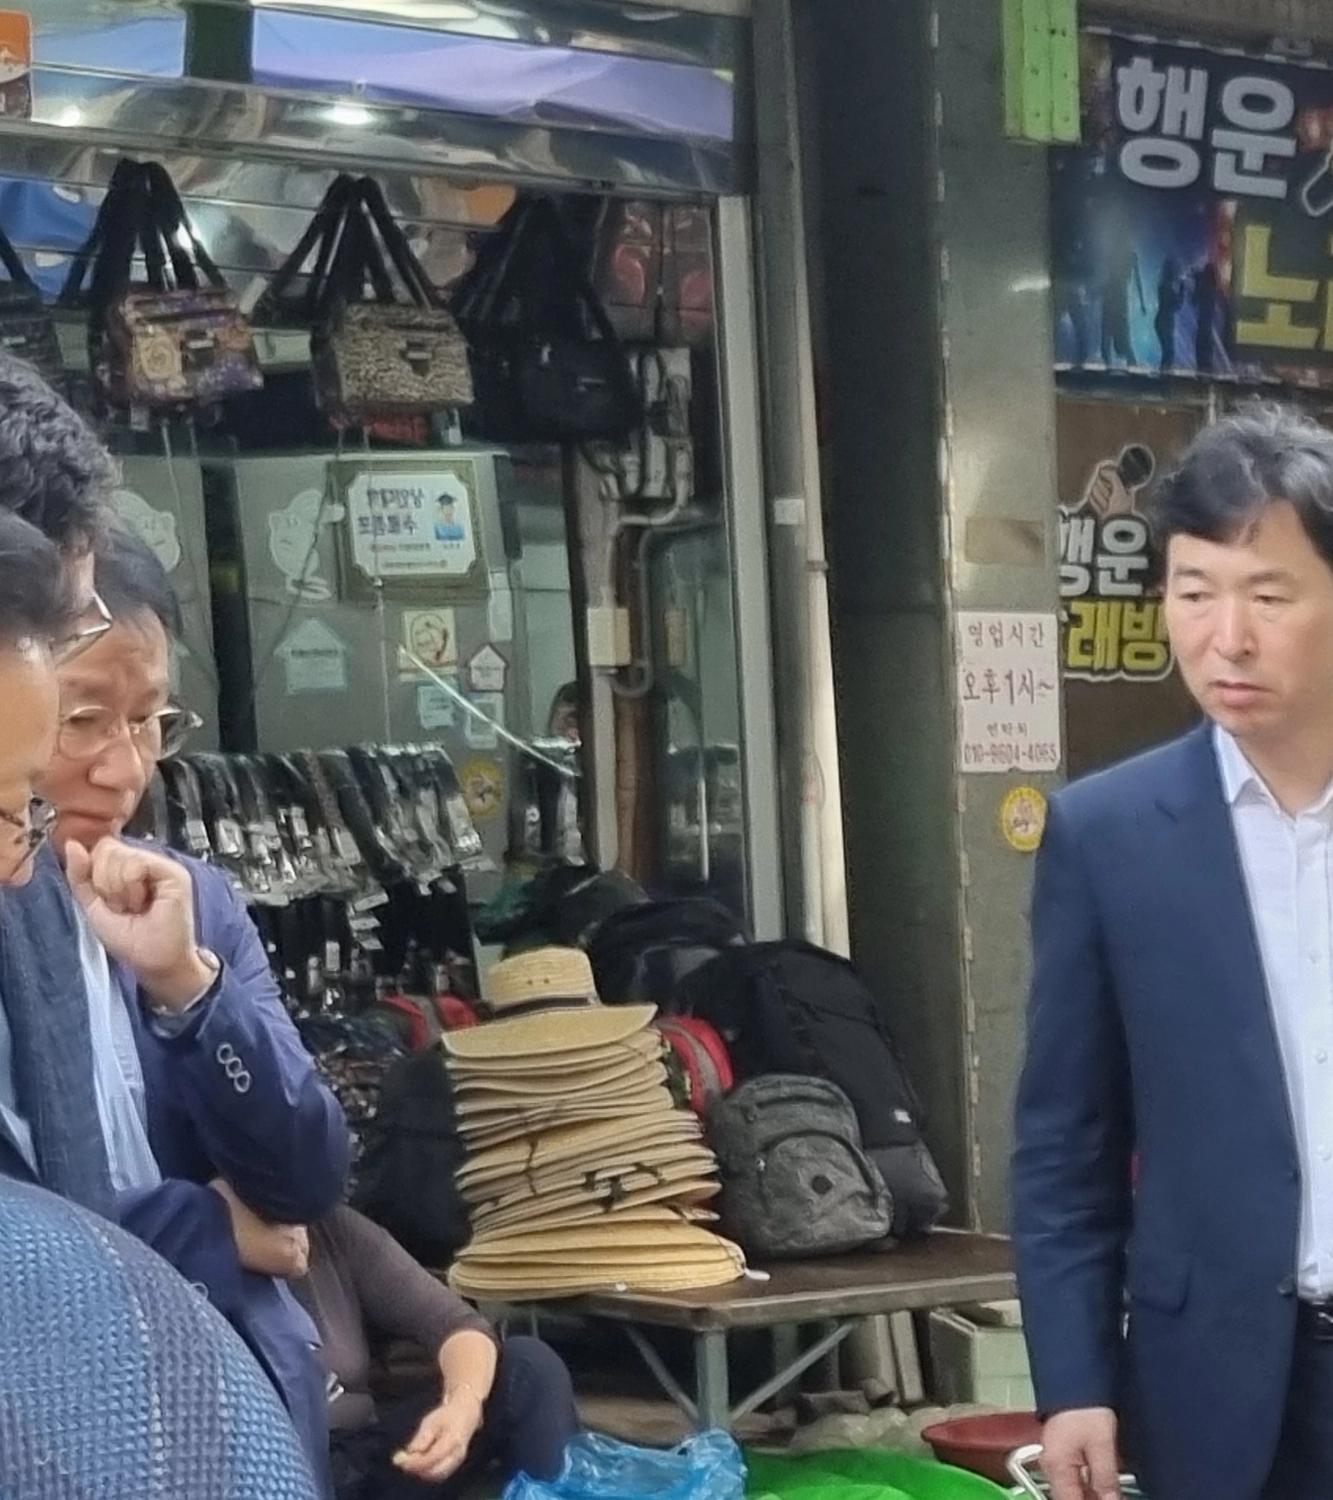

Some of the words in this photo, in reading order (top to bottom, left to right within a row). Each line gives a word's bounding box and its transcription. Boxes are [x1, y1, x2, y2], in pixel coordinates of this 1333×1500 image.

[1116, 54, 1298, 200] 행운
[967, 620, 1046, 650] 영업시간
[1060, 600, 1169, 671] 래방
